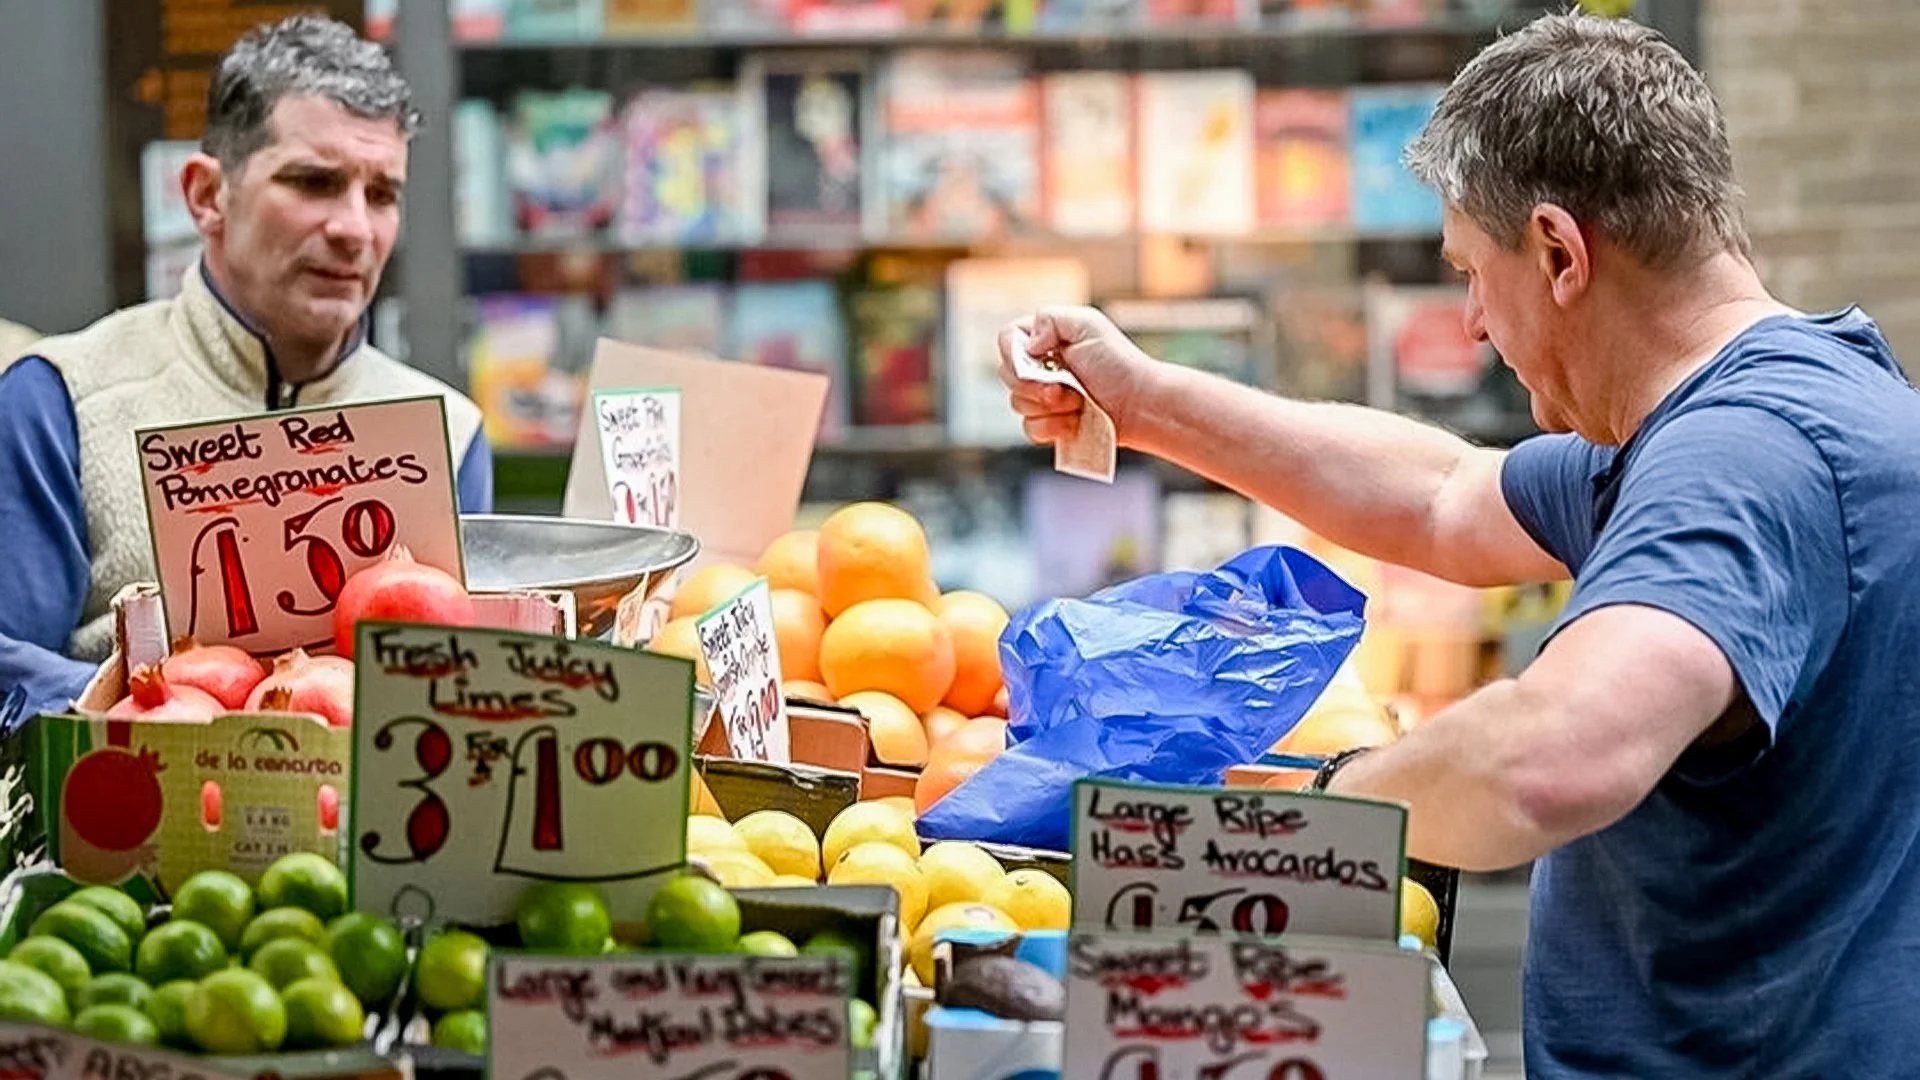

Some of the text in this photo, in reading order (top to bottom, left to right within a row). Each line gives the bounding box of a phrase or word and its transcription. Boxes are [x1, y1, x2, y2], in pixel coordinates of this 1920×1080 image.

[141, 411, 354, 472] Sweet Red
[155, 453, 428, 511] Pomegranates
[371, 629, 620, 702] Fresh Juicy
[429, 678, 577, 717] Limes
[360, 716, 453, 864] 3
[1088, 788, 1309, 850] Large Ripe
[1090, 828, 1185, 869] Hass
[1106, 991, 1322, 1053] Mangos
